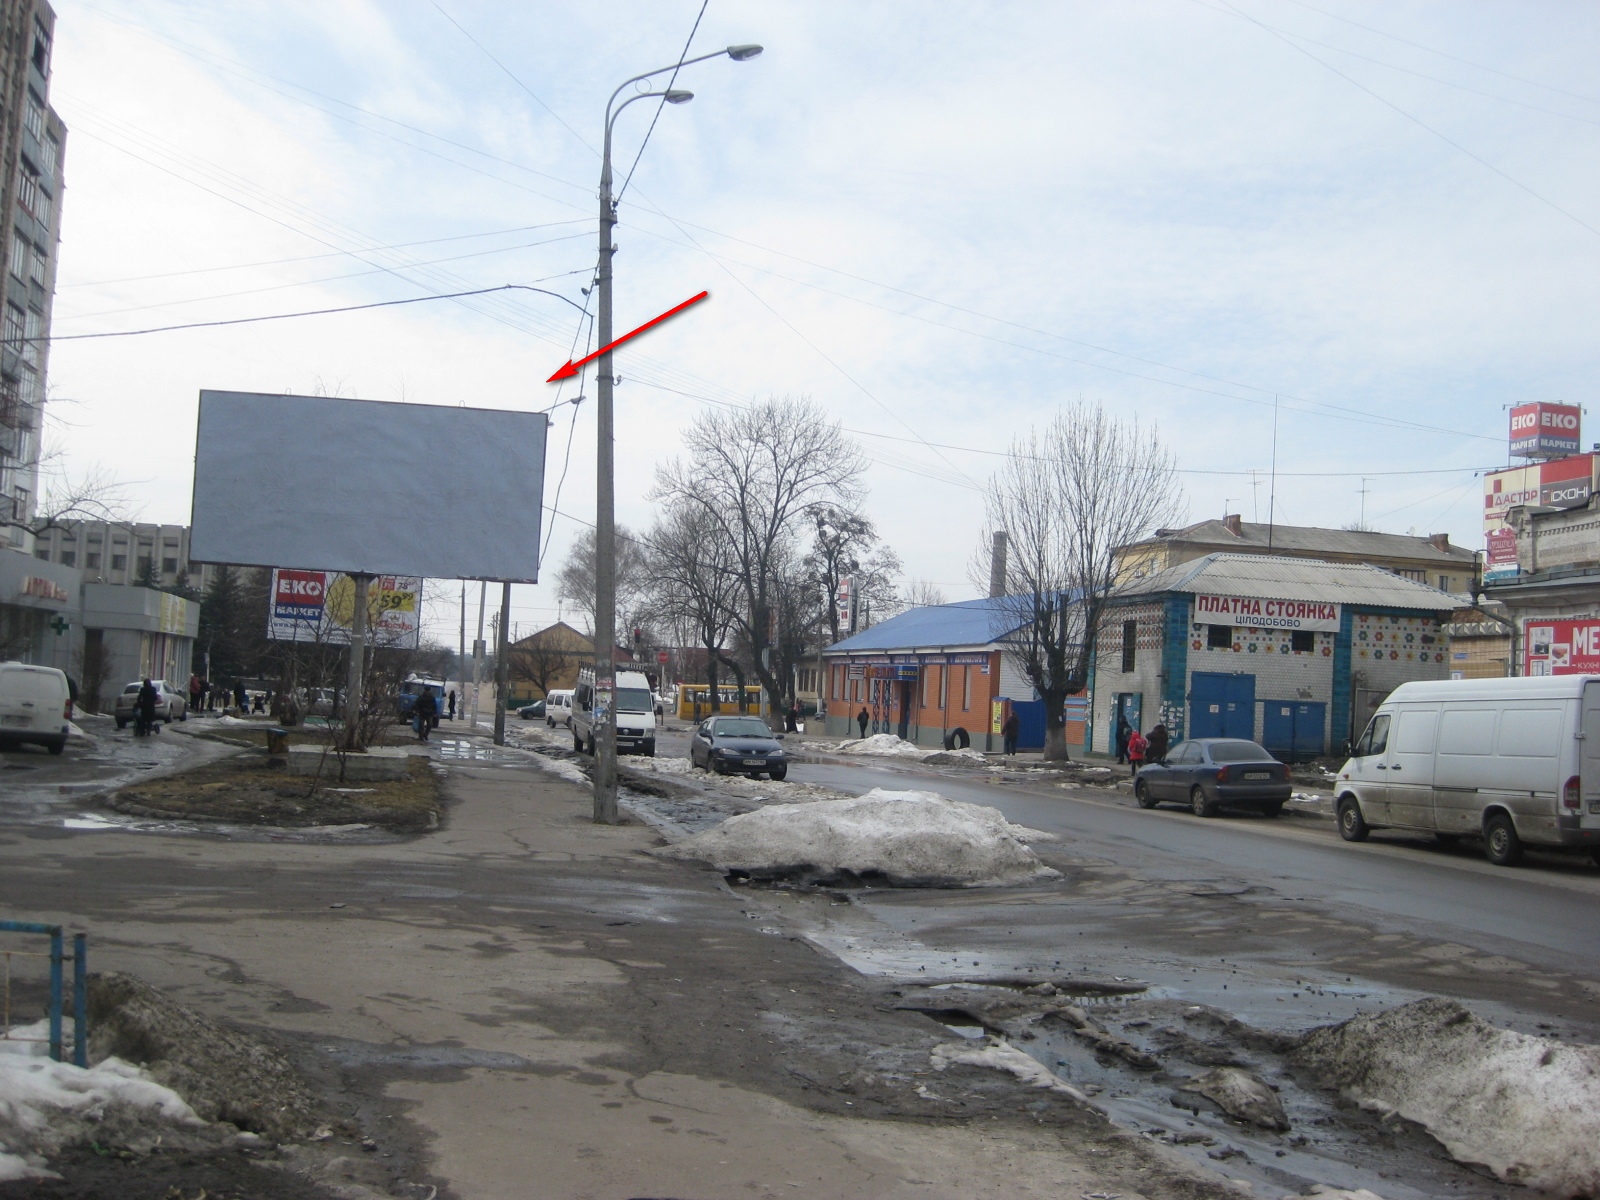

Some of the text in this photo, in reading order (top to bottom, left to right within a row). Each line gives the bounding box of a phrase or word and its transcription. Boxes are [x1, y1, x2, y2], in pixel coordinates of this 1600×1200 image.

[1511, 412, 1536, 430] ЕКО
[1541, 412, 1577, 430] ЕКО
[1510, 438, 1537, 451] МАРКЕТ
[1540, 438, 1578, 450] МАРКЕТ
[279, 579, 321, 596] ЕКО
[1198, 595, 1337, 620] ПЛАТНА СТОЯНКА
[1235, 615, 1301, 628] ЦІЛОДОБОВО
